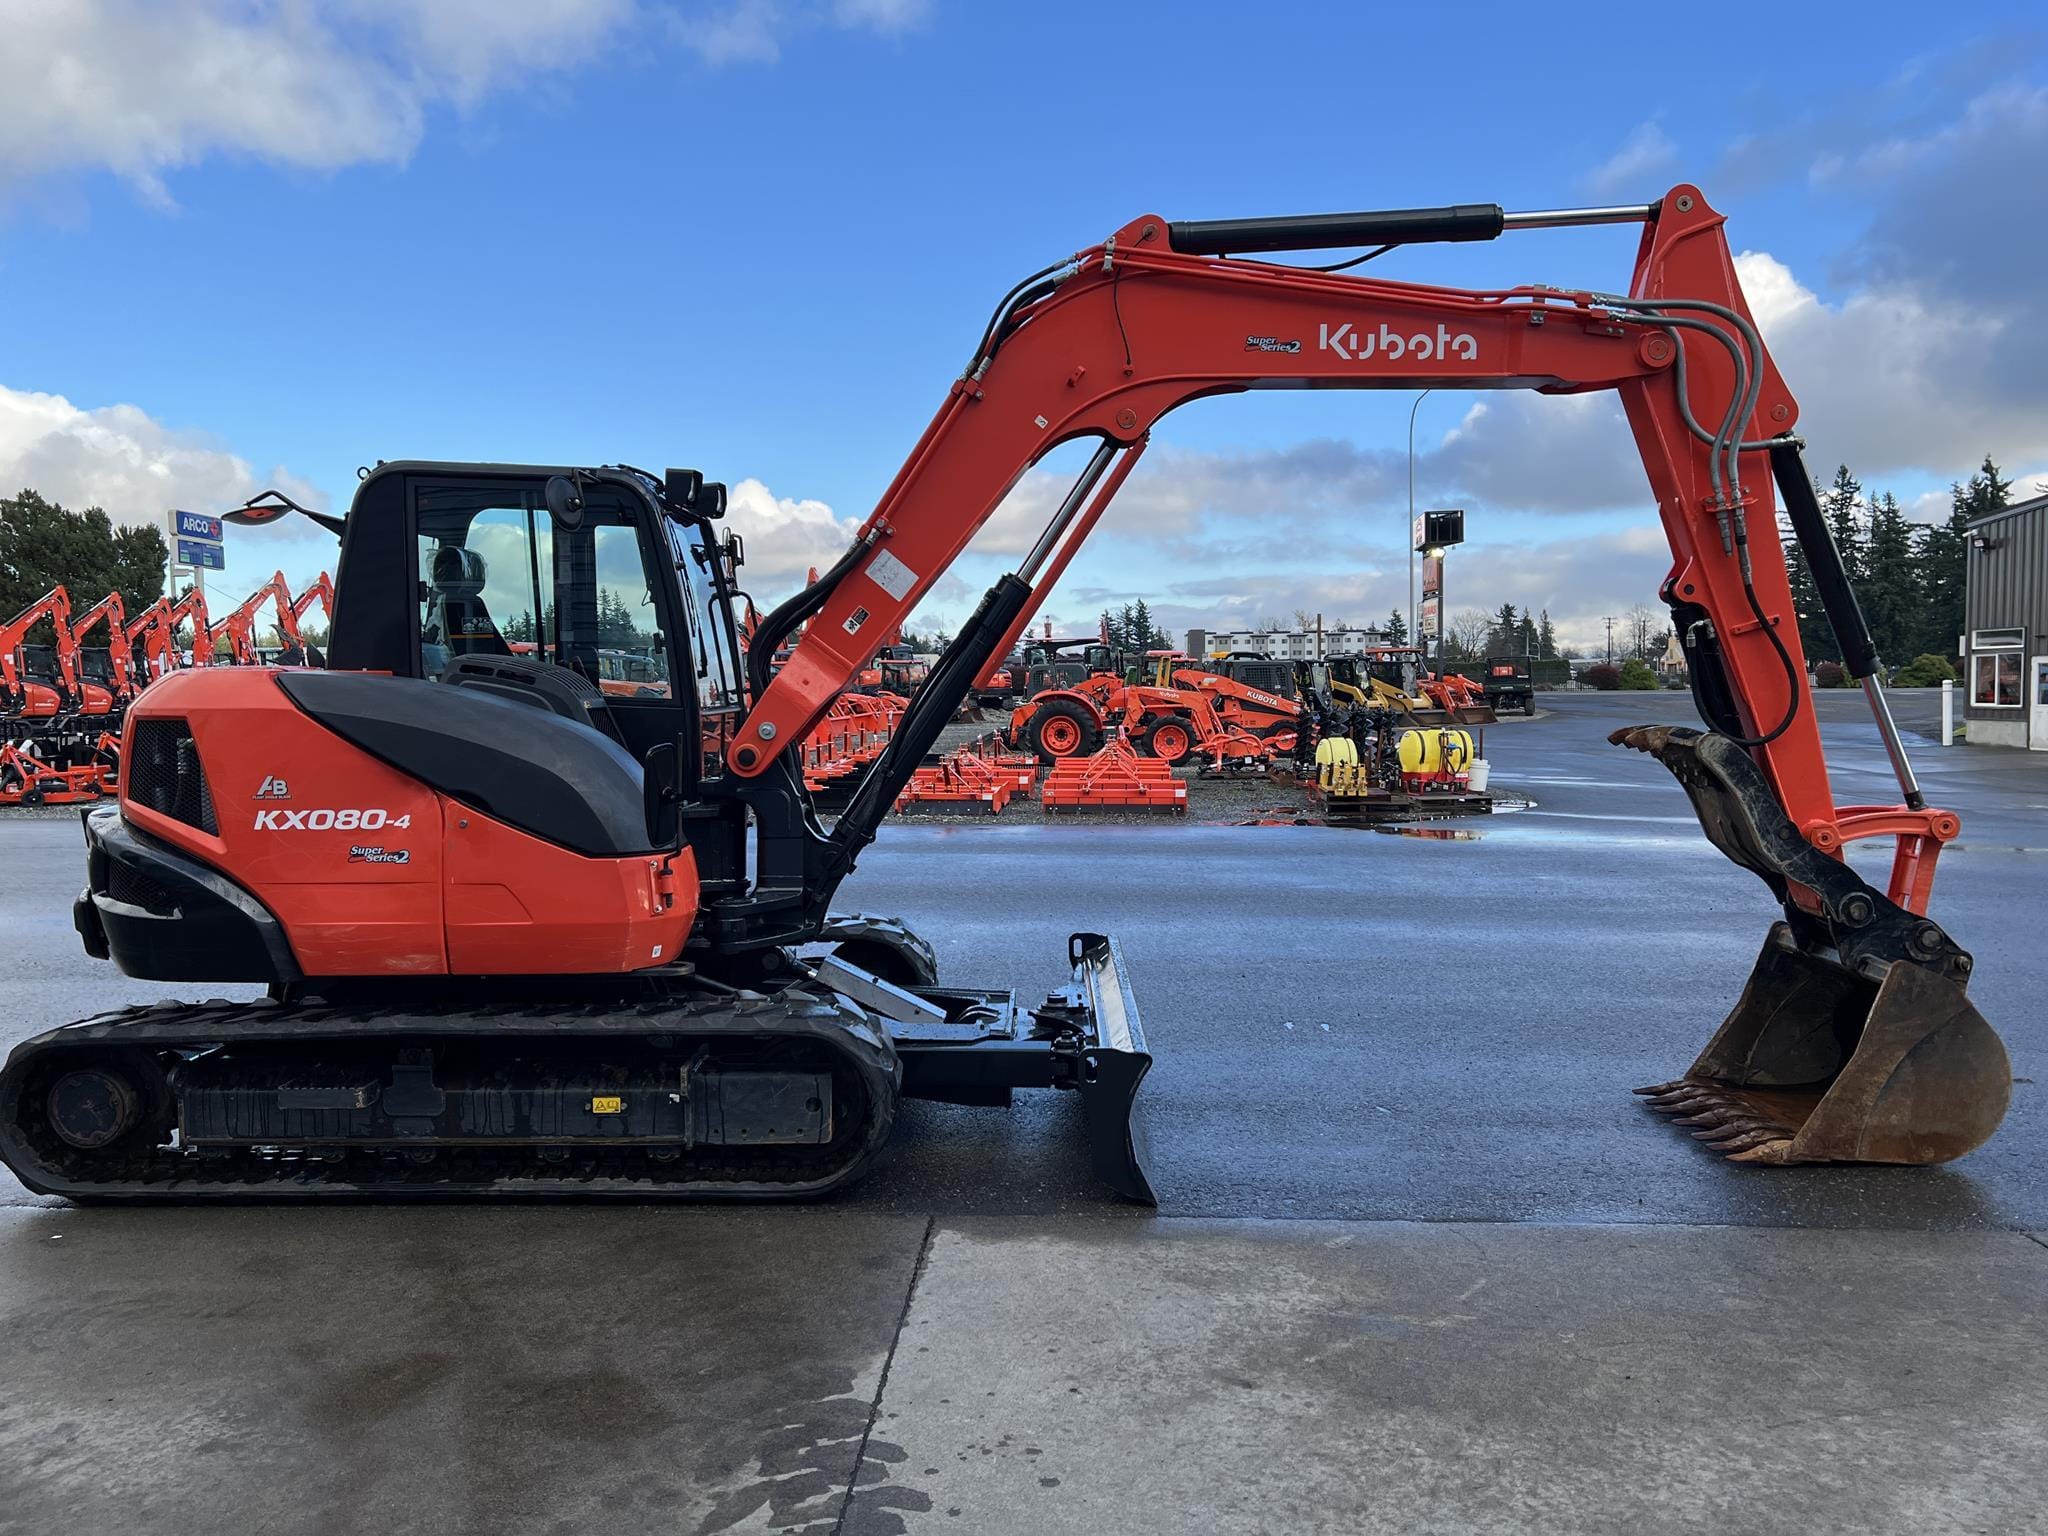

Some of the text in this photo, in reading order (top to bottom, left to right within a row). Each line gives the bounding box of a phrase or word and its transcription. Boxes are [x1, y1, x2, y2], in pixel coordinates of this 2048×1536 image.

[1247, 336, 1276, 345] Super
[1319, 323, 1478, 360] Kubota
[182, 517, 209, 533] ARCO
[1247, 690, 1278, 706] KUBOTA
[257, 775, 288, 795] AB
[253, 809, 411, 831] KX080-4
[350, 846, 384, 857] Super
